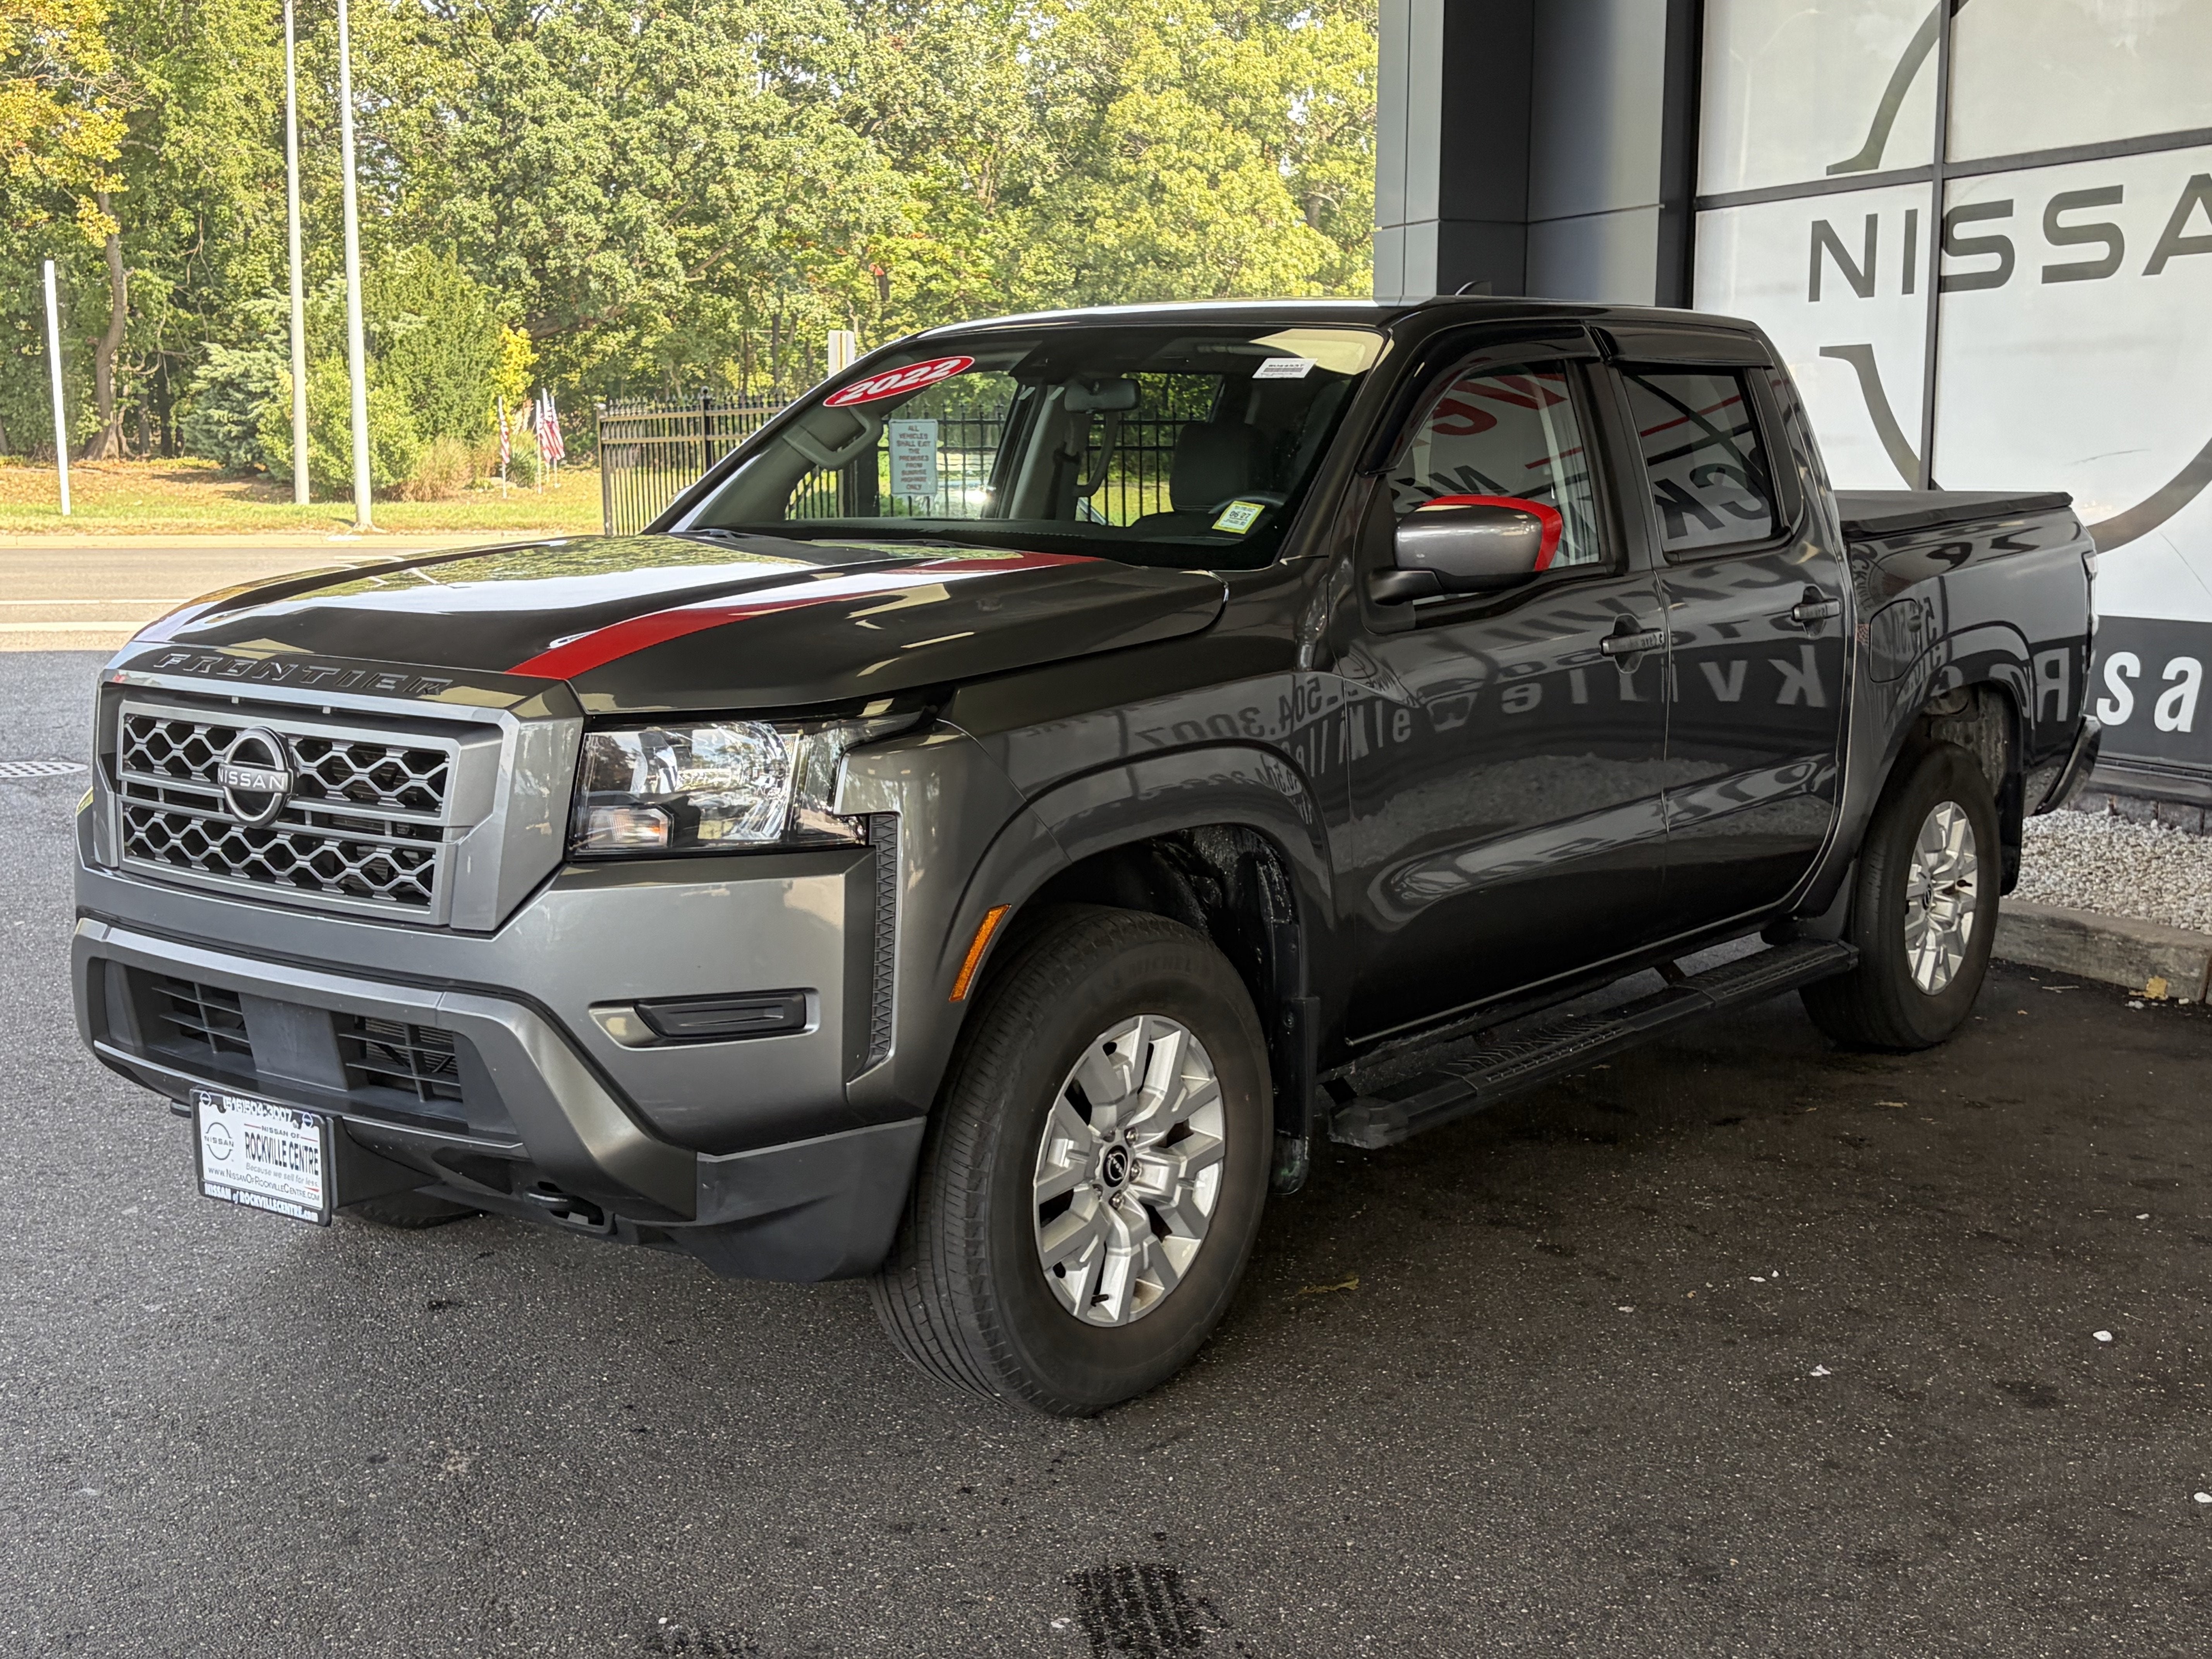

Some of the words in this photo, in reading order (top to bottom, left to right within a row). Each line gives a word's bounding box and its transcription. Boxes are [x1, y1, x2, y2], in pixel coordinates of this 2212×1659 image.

[835, 358, 961, 404] 2022
[153, 653, 454, 696] FRONTIER
[218, 767, 286, 790] NISSAN
[204, 1135, 234, 1147] NISSAN
[262, 1125, 288, 1137] NISSAN
[245, 1132, 287, 1167] ROCKVILLE
[289, 1142, 319, 1175] CENTRE
[246, 1162, 271, 1176] Because
[273, 1170, 282, 1178] we
[283, 1171, 294, 1182] sell
[295, 1175, 305, 1184] for
[204, 1183, 232, 1201] NISSAN
